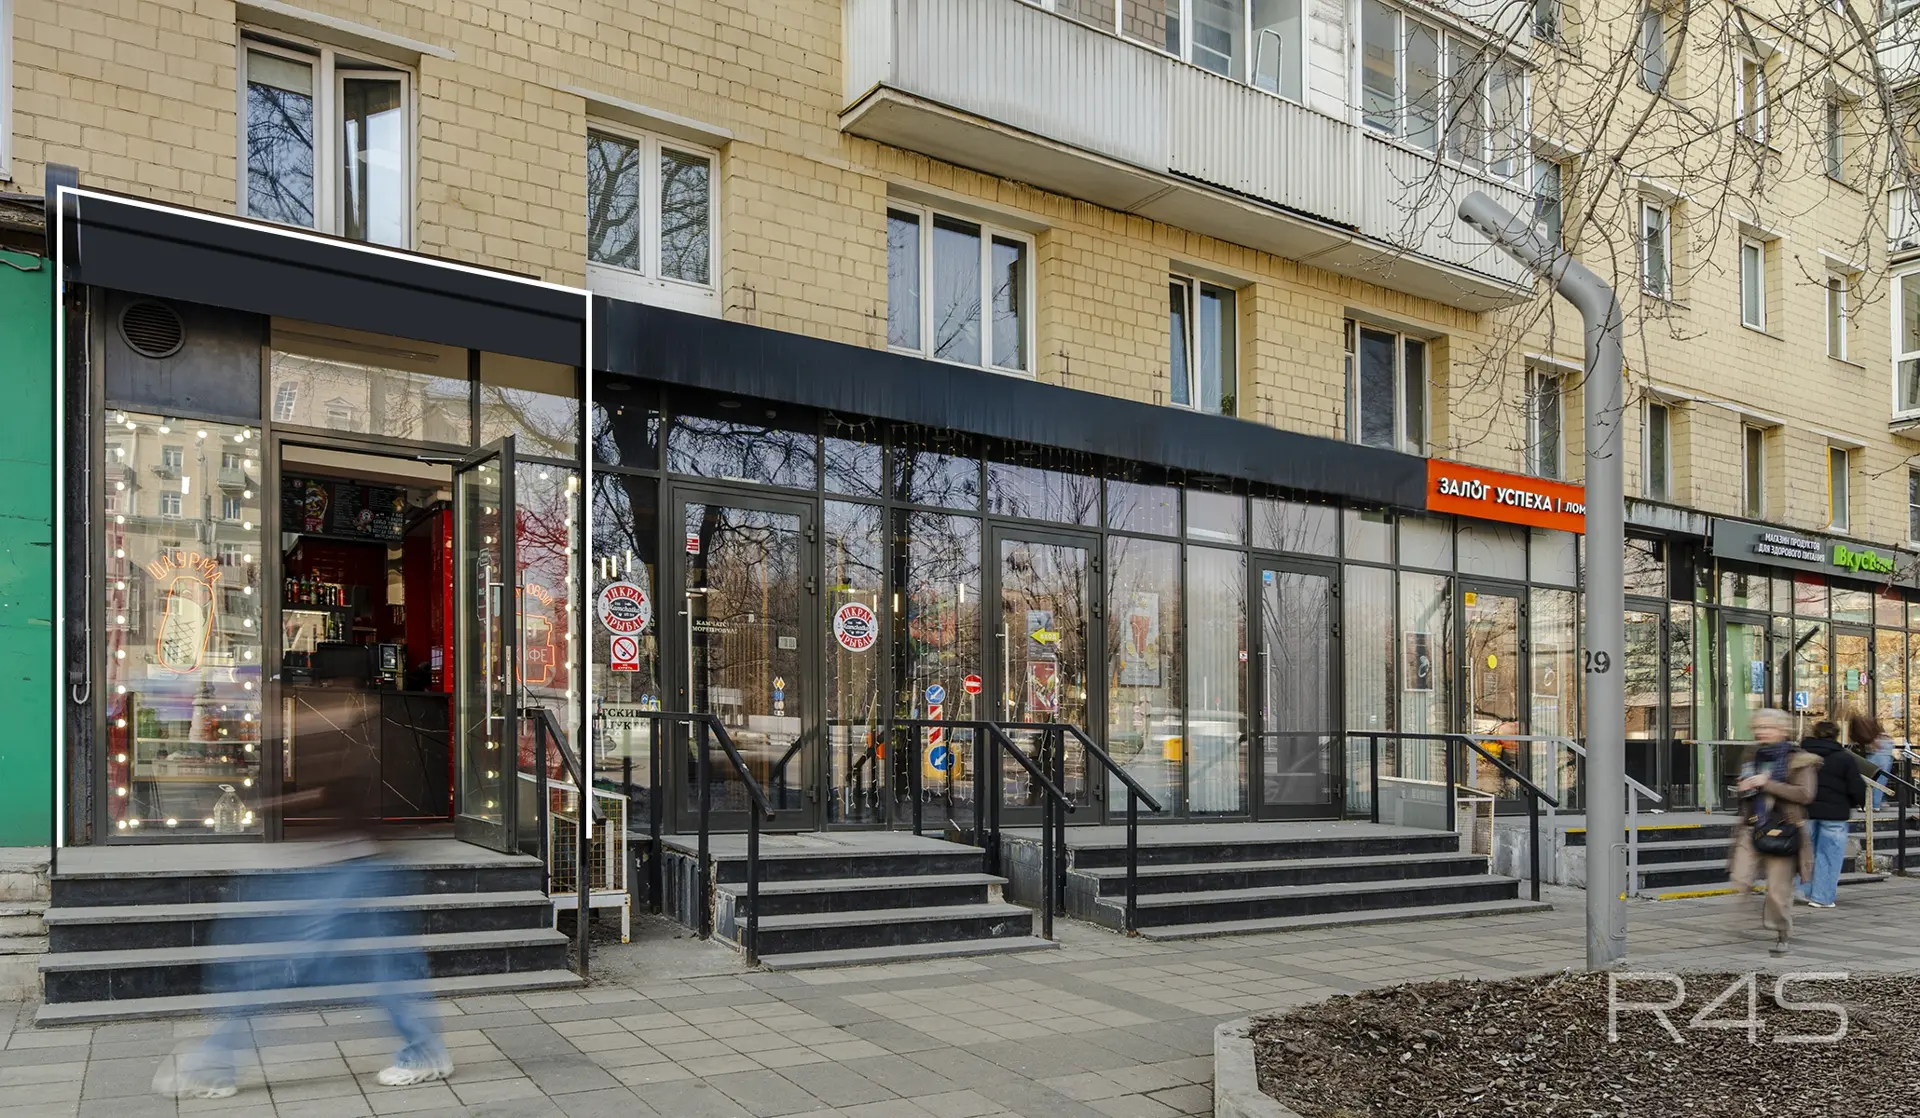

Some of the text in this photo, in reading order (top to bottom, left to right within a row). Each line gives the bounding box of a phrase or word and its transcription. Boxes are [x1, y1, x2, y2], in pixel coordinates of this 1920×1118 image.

[1440, 477, 1587, 515] ЗАЛОГ УСПЕХА ЛОМ
[1765, 533, 1821, 551] МАГАЗИН ПРОДУКТОВ
[1758, 543, 1825, 563] ДЛЯ ЗДОРОВОГО ПИТАНИЯ
[147, 551, 222, 585] ШАУРМА
[610, 586, 640, 604] ИКРА
[609, 619, 640, 632] РЫБА
[843, 636, 869, 648] РЫБА
